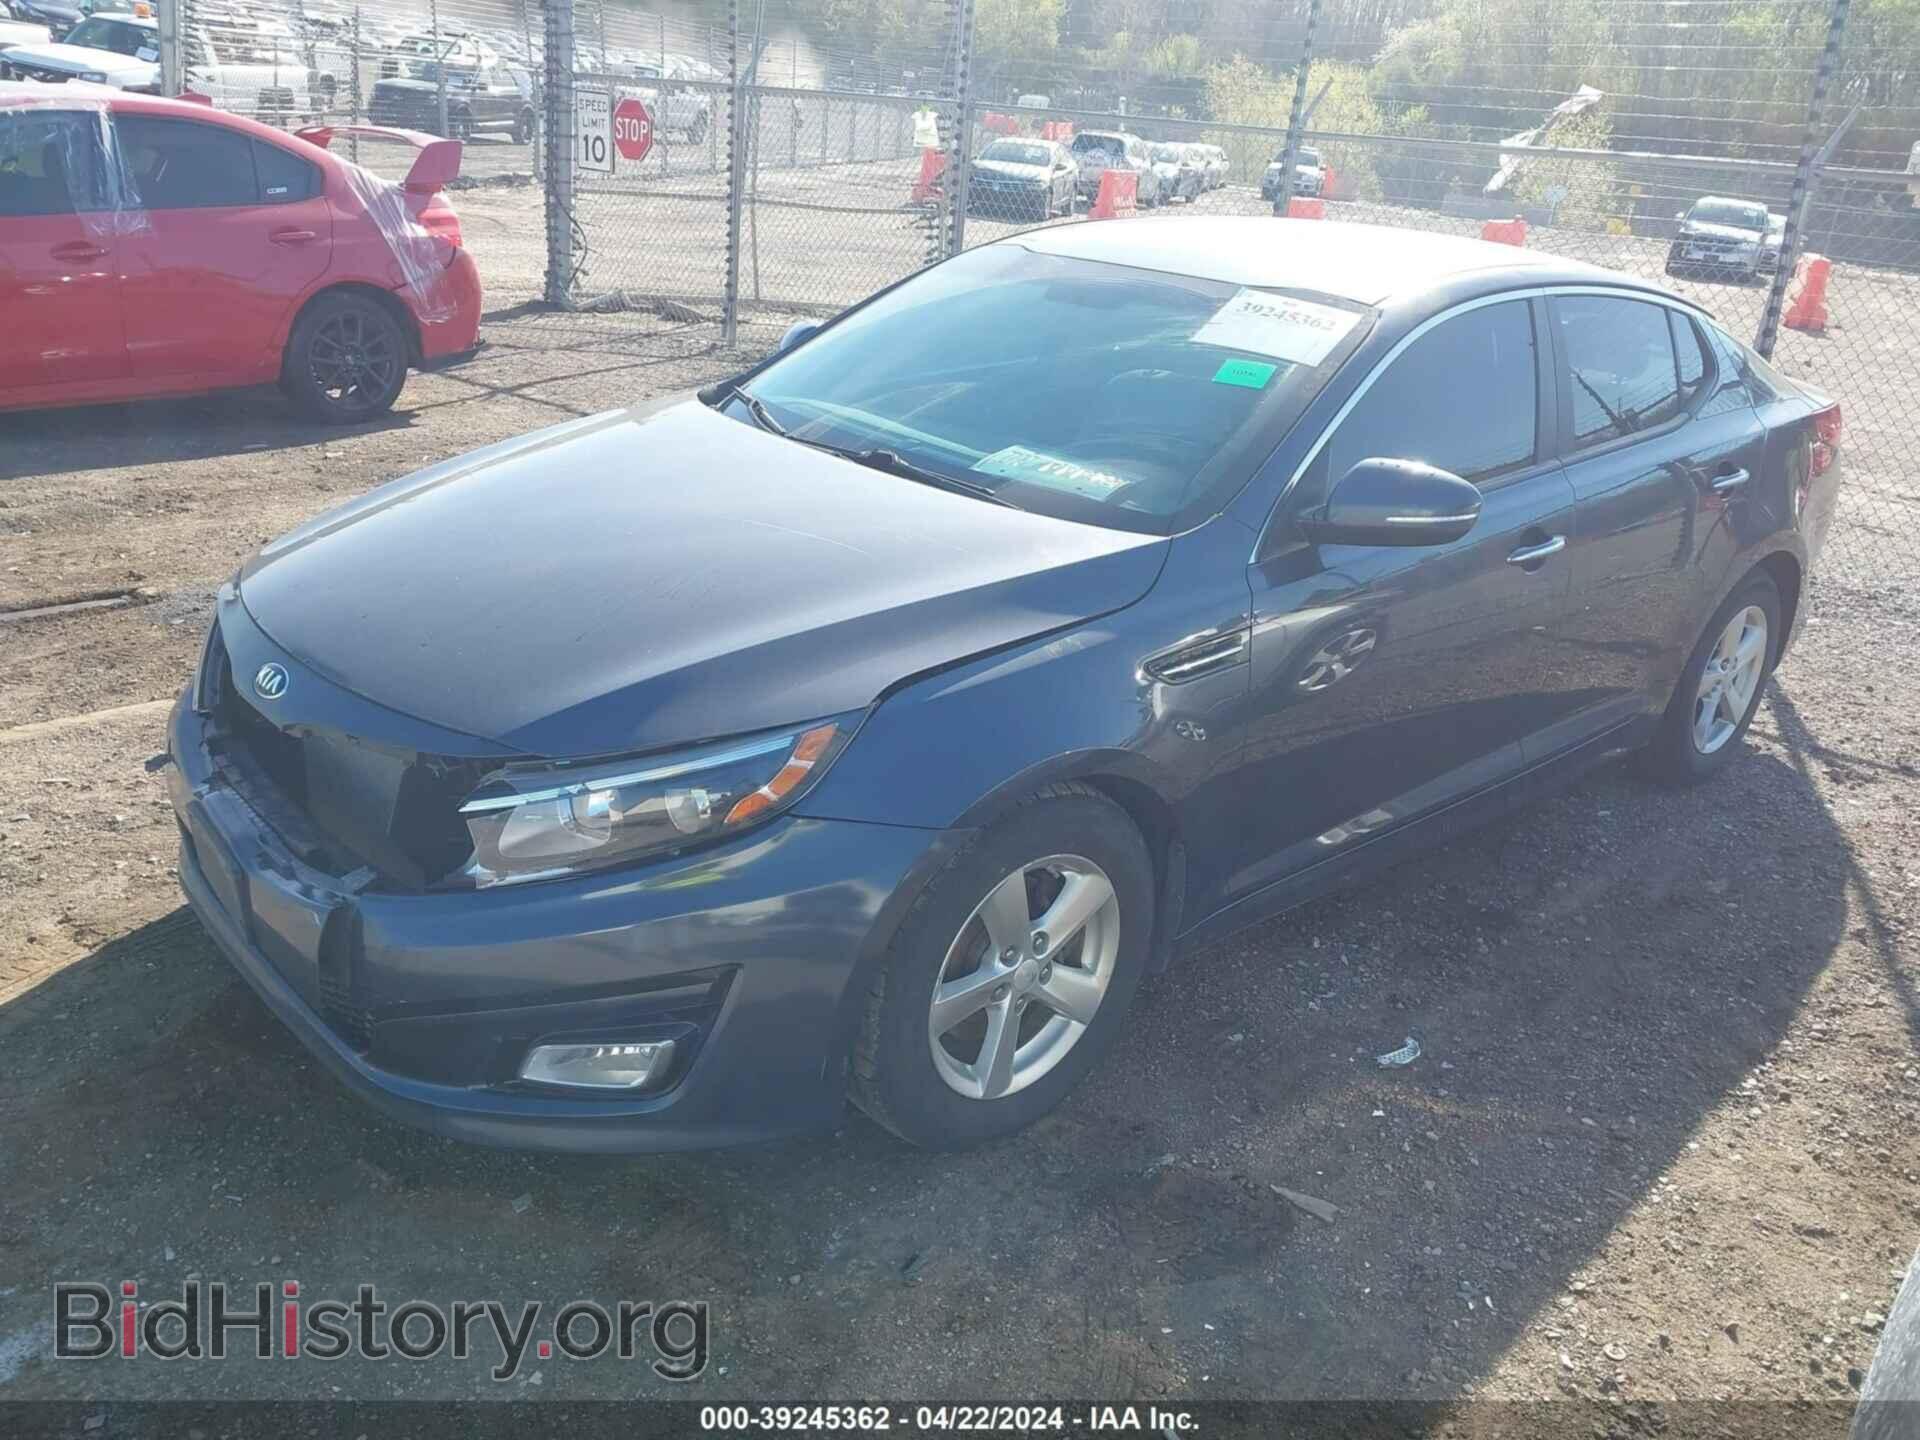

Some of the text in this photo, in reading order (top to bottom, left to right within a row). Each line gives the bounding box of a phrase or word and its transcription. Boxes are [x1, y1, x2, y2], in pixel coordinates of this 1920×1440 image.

[579, 99, 608, 113] SPEED
[583, 117, 606, 129] LIMIT
[615, 117, 648, 142] STOP
[584, 134, 605, 163] 10
[1236, 302, 1336, 331] 39245362
[258, 667, 282, 694] KIA
